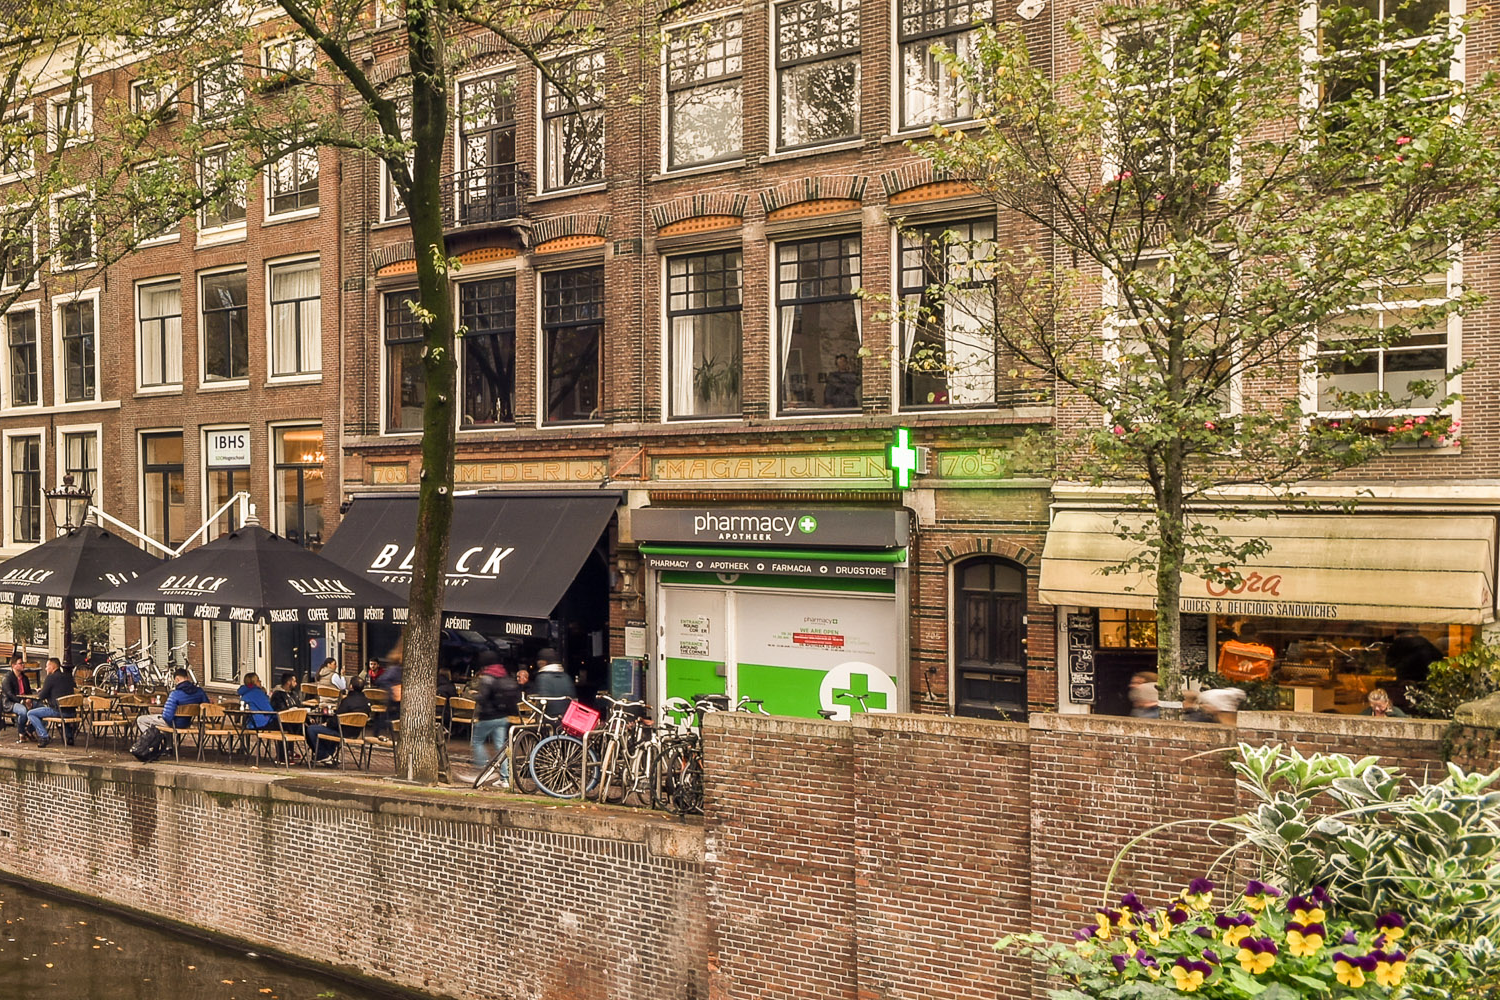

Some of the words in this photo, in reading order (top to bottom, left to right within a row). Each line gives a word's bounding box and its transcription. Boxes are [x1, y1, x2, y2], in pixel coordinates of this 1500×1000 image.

[215, 435, 245, 449] IBHS
[666, 456, 888, 478] MAGAZIJNEN
[943, 455, 999, 476] 705
[374, 467, 407, 483] 703
[694, 512, 796, 536] pharmacy
[718, 533, 772, 541] APOTHEEK
[370, 543, 515, 574] BLCK
[2, 567, 54, 582] BLACK
[650, 559, 690, 569] PHARMACY
[709, 561, 750, 571] APOTHEEK
[771, 564, 812, 574] FARMACIA
[835, 565, 887, 576] DRUGSTORE
[159, 574, 228, 592] BLACK
[288, 578, 354, 593] BLACK
[0, 592, 15, 604] LUNCH
[20, 592, 41, 606] APÉRITIF
[45, 596, 63, 609] DINNER
[1181, 599, 1211, 613] JUICES
[1215, 602, 1222, 612] &
[1227, 602, 1274, 616] DELICIOUS
[1277, 604, 1338, 618] SANDWICHES
[96, 601, 128, 614] BREAKFAST
[136, 602, 156, 615] COFFEE
[164, 602, 184, 616] LUNCH
[194, 603, 221, 619] APÉRITIF
[229, 607, 255, 622] DINNER
[269, 609, 299, 622] BREAKFAST
[307, 608, 329, 621] COFFEE
[337, 607, 356, 620] LUNCH
[363, 605, 385, 621] APÉRITIF
[803, 616, 832, 624] pharmacy
[444, 615, 472, 631] APÉRITIF
[505, 622, 533, 636] DINNER
